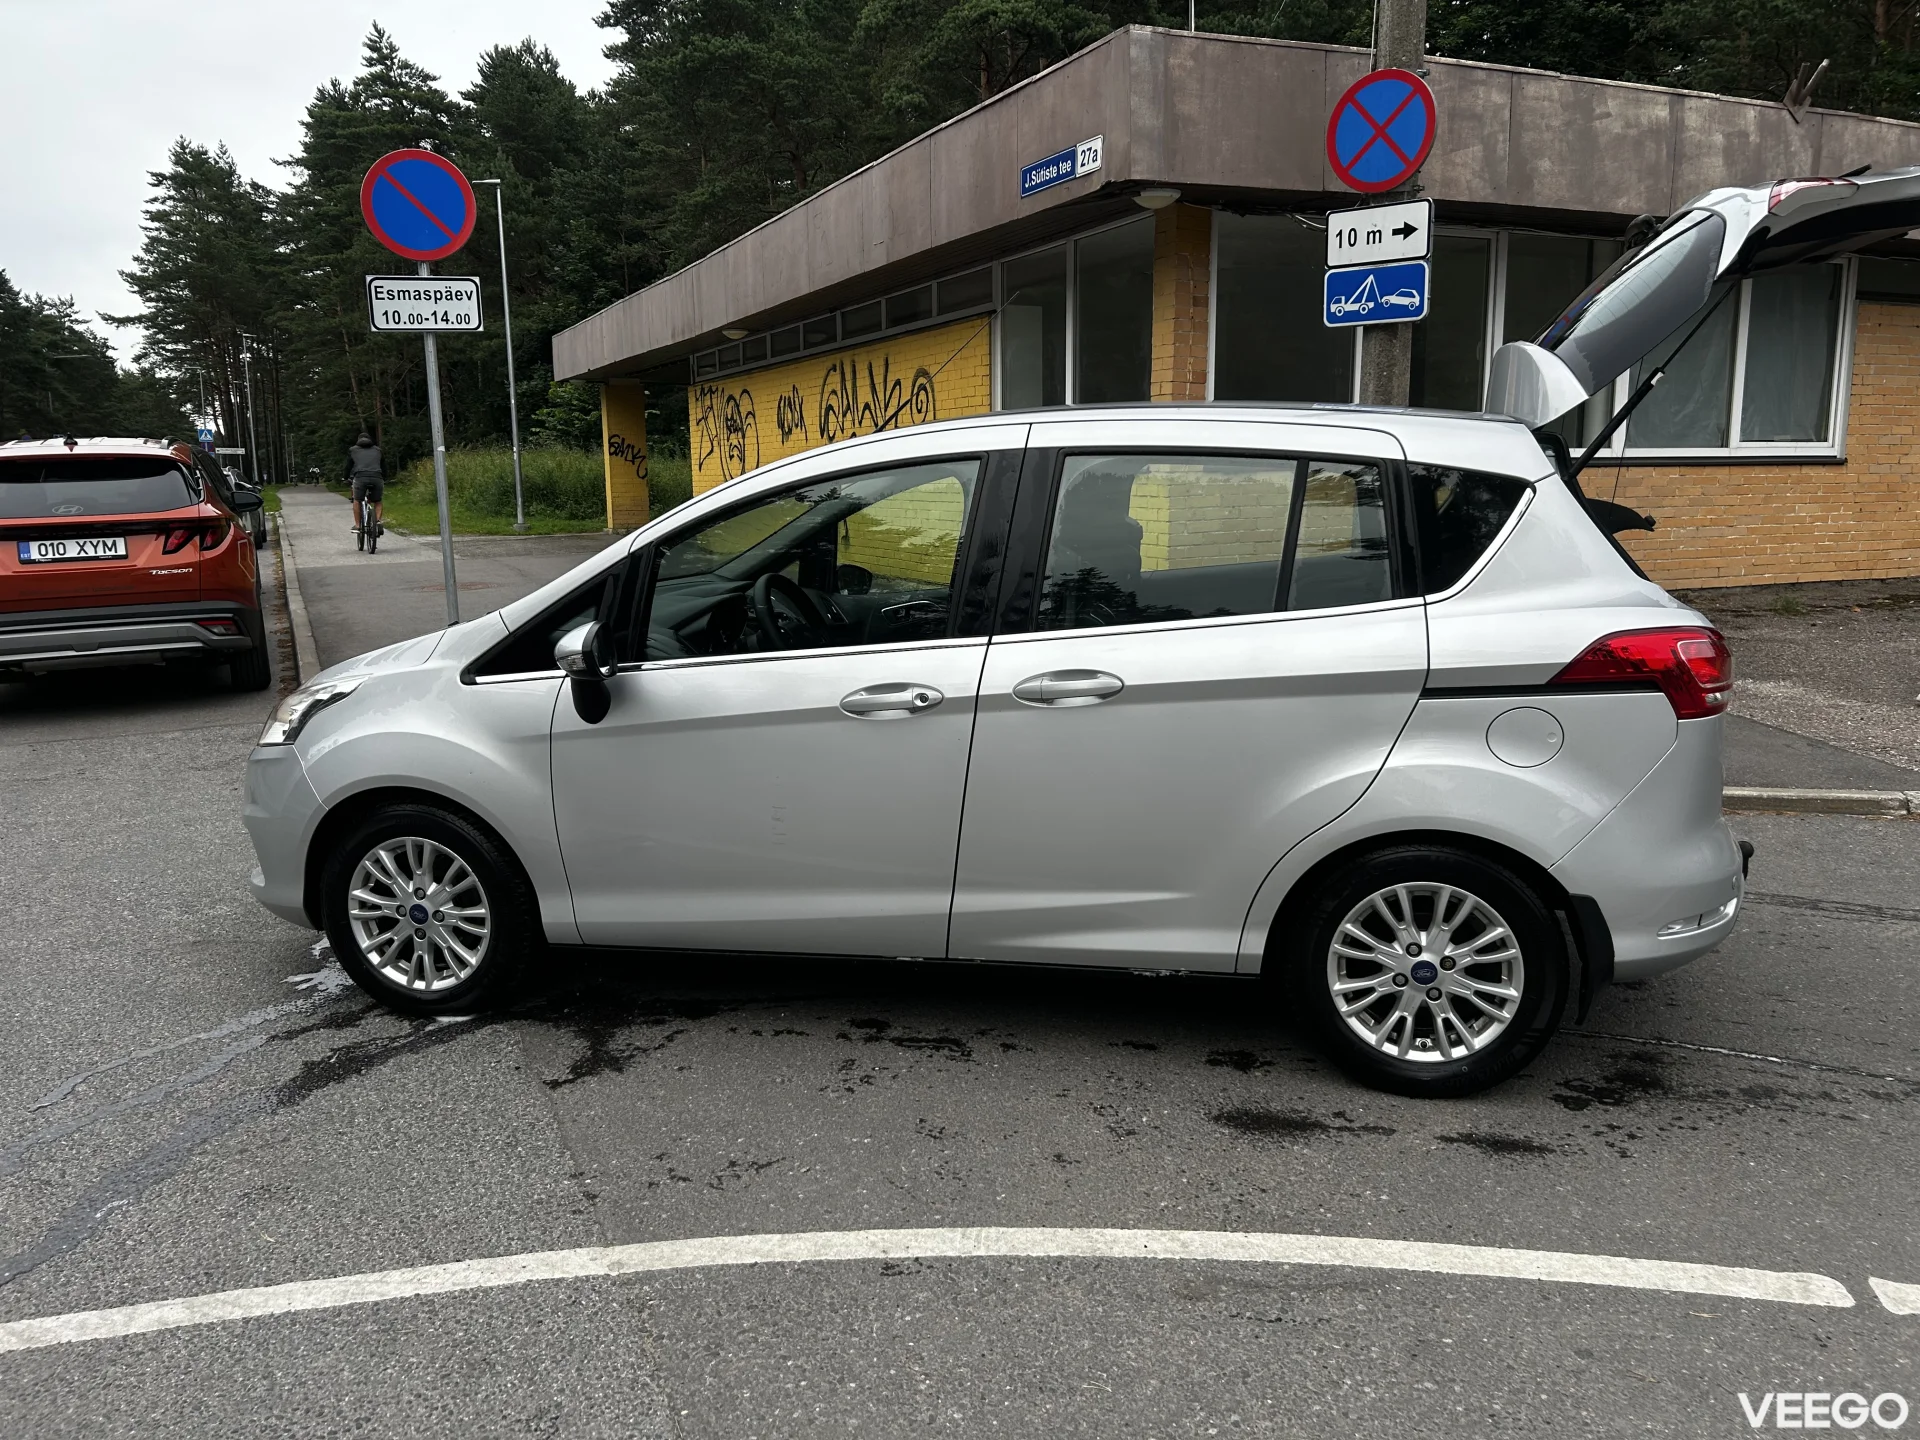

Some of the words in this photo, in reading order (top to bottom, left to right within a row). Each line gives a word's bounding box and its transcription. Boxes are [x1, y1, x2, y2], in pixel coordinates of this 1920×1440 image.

[1080, 146, 1099, 168] 27a
[1024, 164, 1058, 188] J.Sütiste
[1059, 159, 1072, 175] tee
[1335, 227, 1358, 249] 10
[1366, 229, 1383, 245] m
[373, 285, 474, 305] Esmaspäev
[382, 309, 471, 325] 10.00-14.00
[37, 541, 67, 557] 010
[75, 539, 118, 556] XYM
